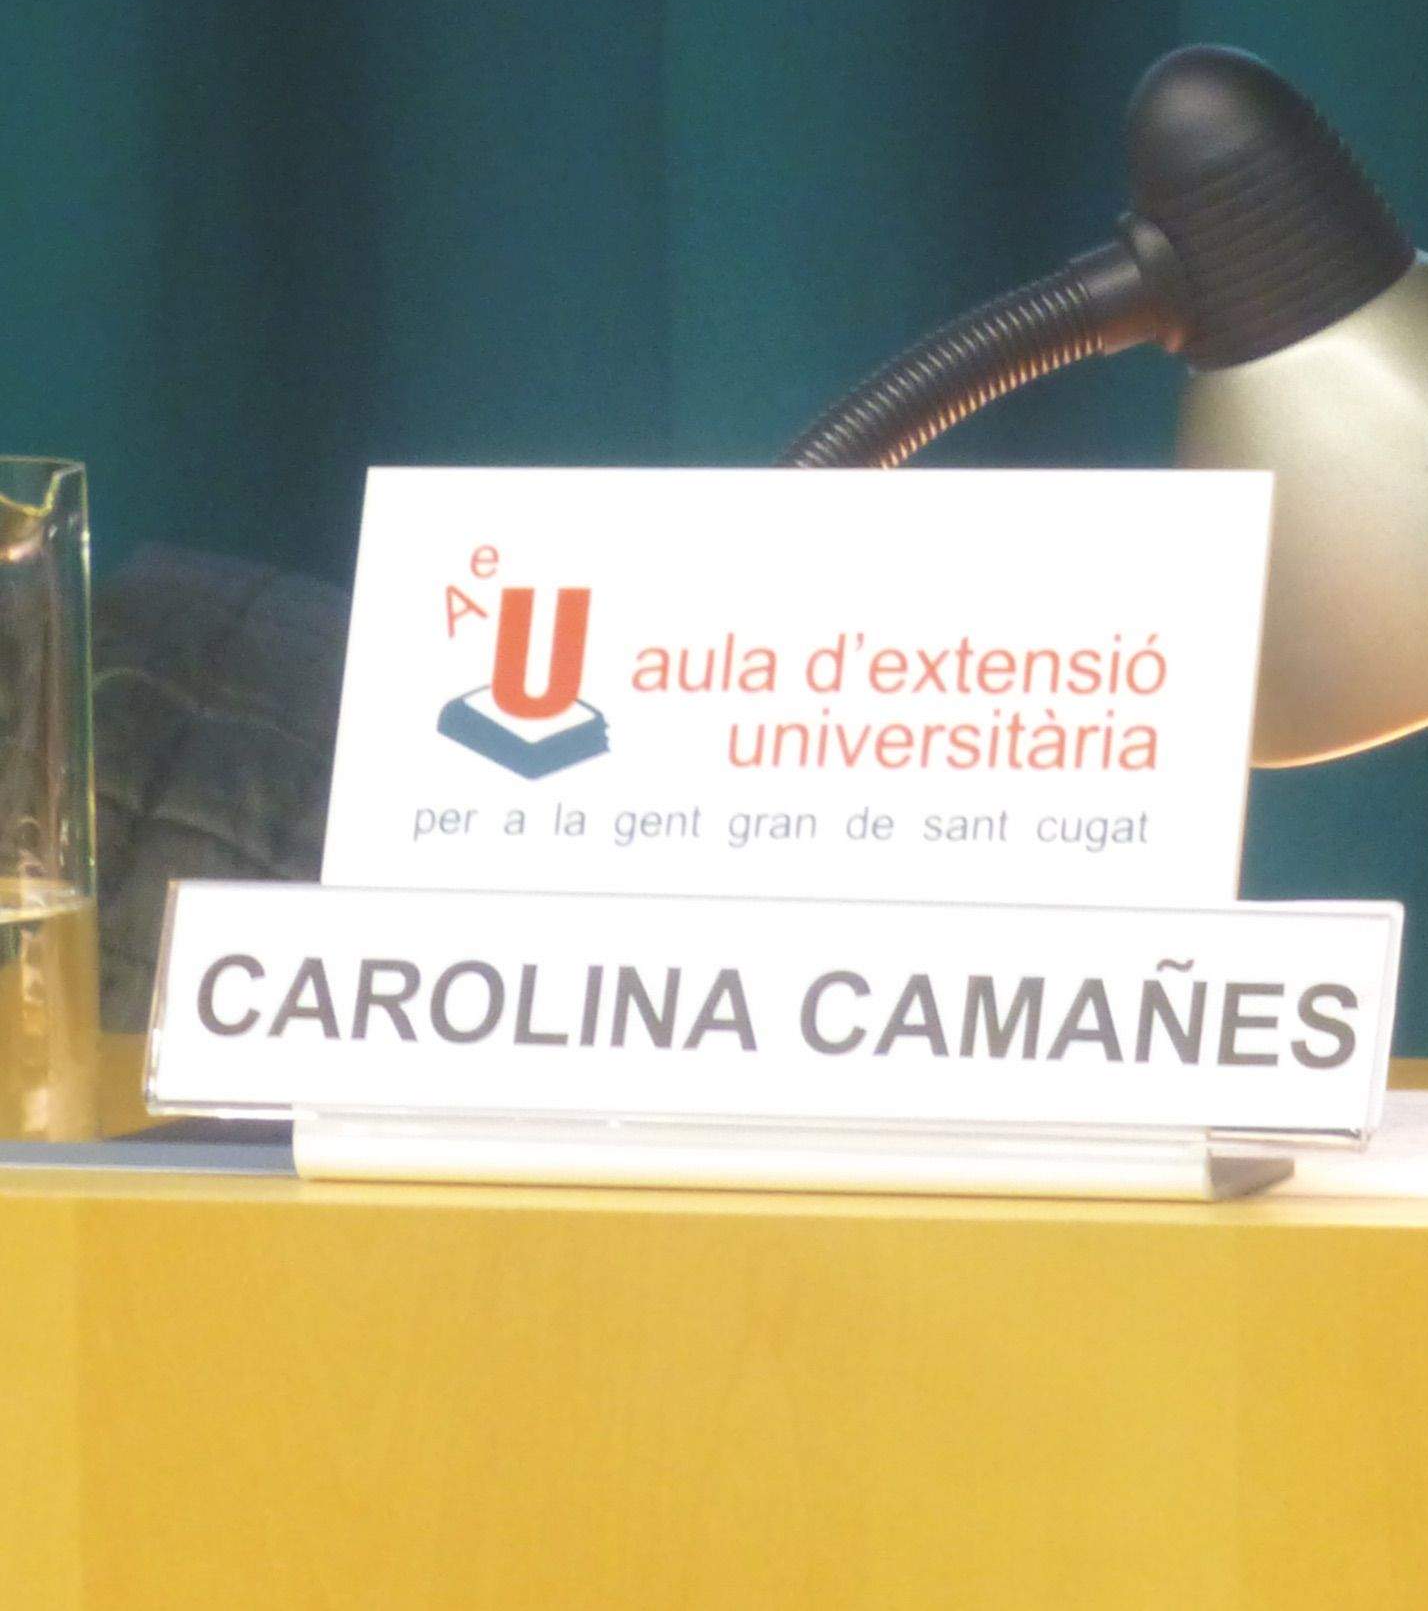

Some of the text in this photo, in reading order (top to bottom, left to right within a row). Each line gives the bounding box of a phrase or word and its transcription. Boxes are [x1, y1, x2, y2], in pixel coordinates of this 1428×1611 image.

[631, 632, 1169, 697] aula d'extensió
[728, 707, 1159, 773] universitària
[413, 802, 1150, 854] per a la gent gran de sant cugat
[197, 953, 1360, 1071] CAROLINA CAMAÑES
